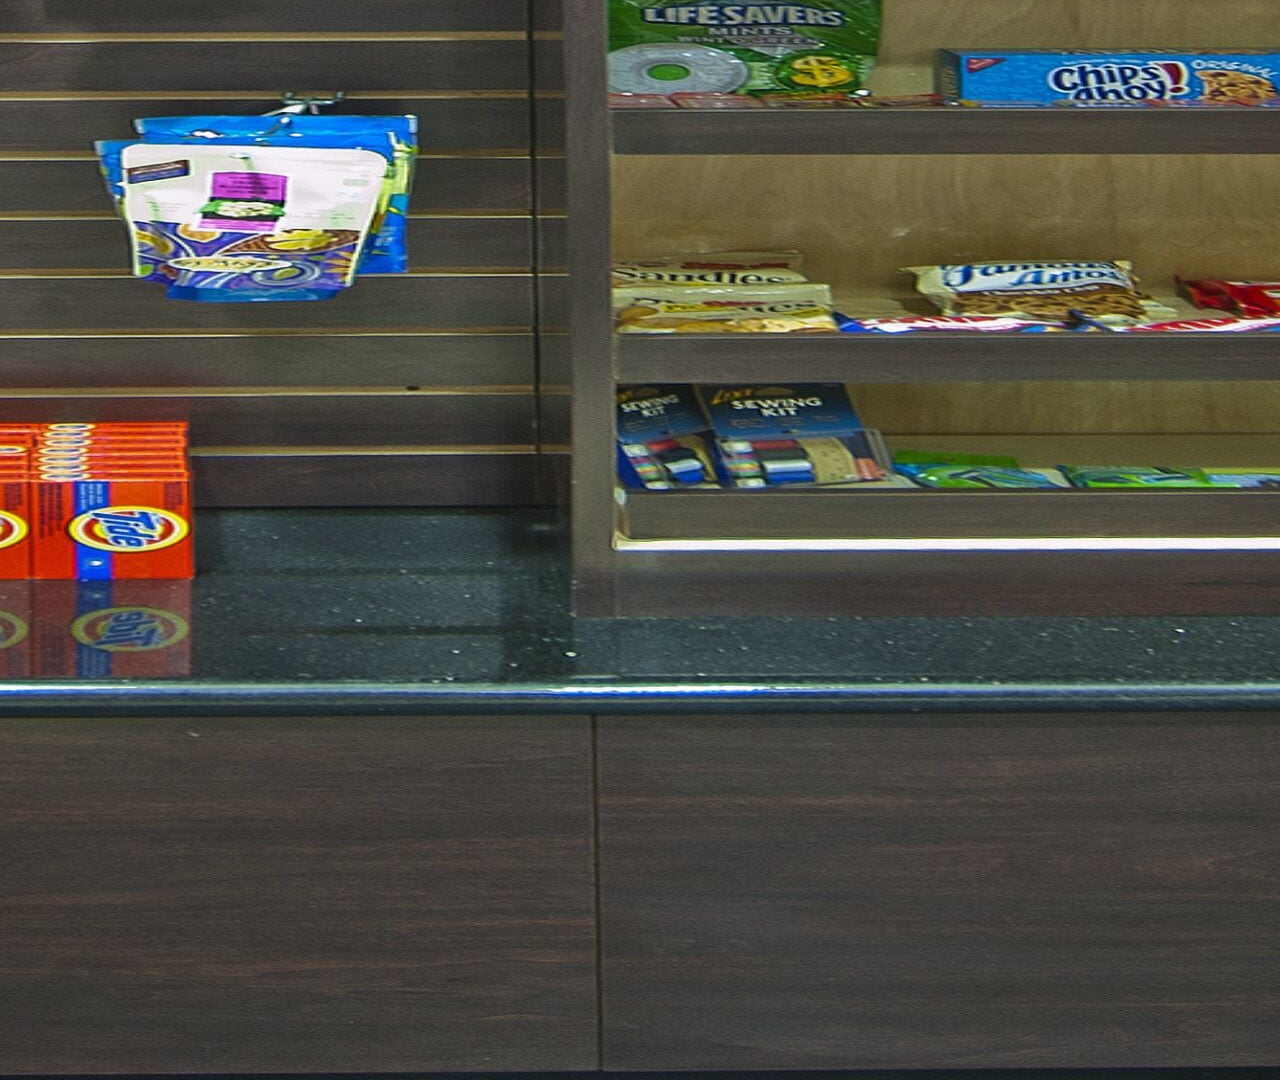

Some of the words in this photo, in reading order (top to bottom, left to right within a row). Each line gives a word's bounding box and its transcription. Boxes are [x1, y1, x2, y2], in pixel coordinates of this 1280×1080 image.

[709, 26, 793, 36] MINTS
[730, 397, 823, 411] SEWING
[760, 407, 798, 418] KIT
[89, 510, 159, 548] Tide
